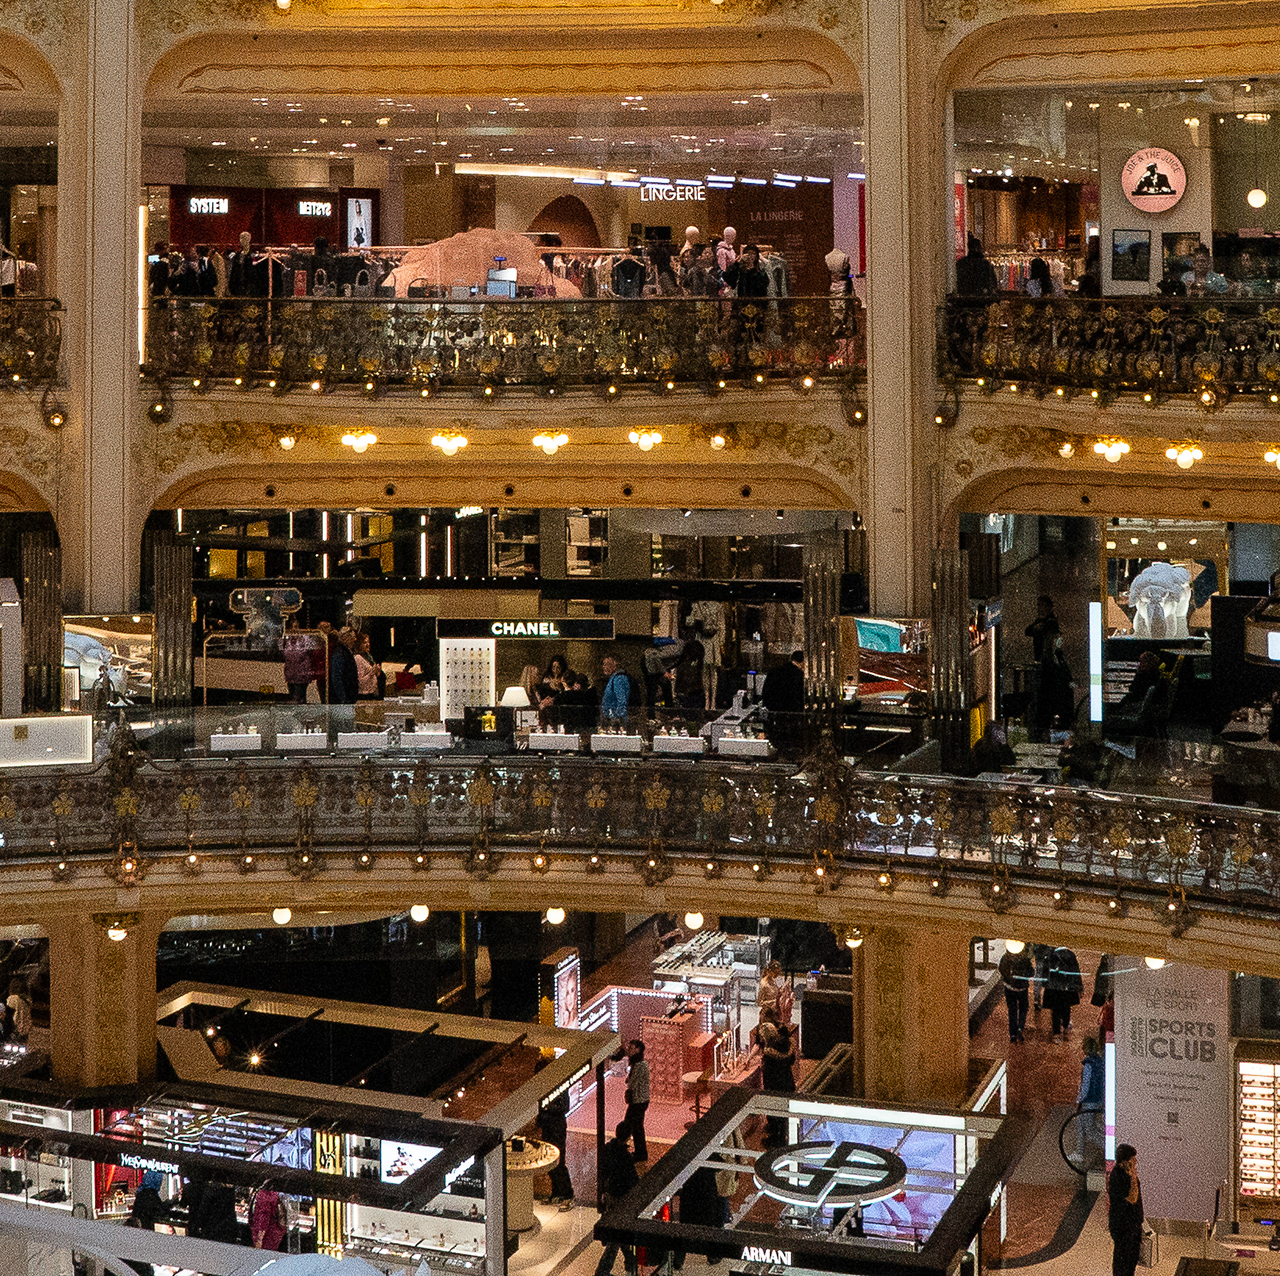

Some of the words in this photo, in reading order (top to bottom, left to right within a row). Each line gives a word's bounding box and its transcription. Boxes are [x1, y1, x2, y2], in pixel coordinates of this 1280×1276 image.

[1126, 158, 1138, 175] JOE
[1145, 151, 1161, 159] THE
[1160, 153, 1181, 174] JUICE
[640, 186, 706, 201] LINGERIE
[189, 198, 229, 213] SYSTEM
[750, 212, 761, 221] LA
[764, 210, 803, 221] LINGERIE
[491, 622, 559, 635] CHANEL
[1148, 1018, 1216, 1038] SPORTS
[1148, 1037, 1216, 1062] CLUB
[741, 1246, 792, 1265] ARMANI
